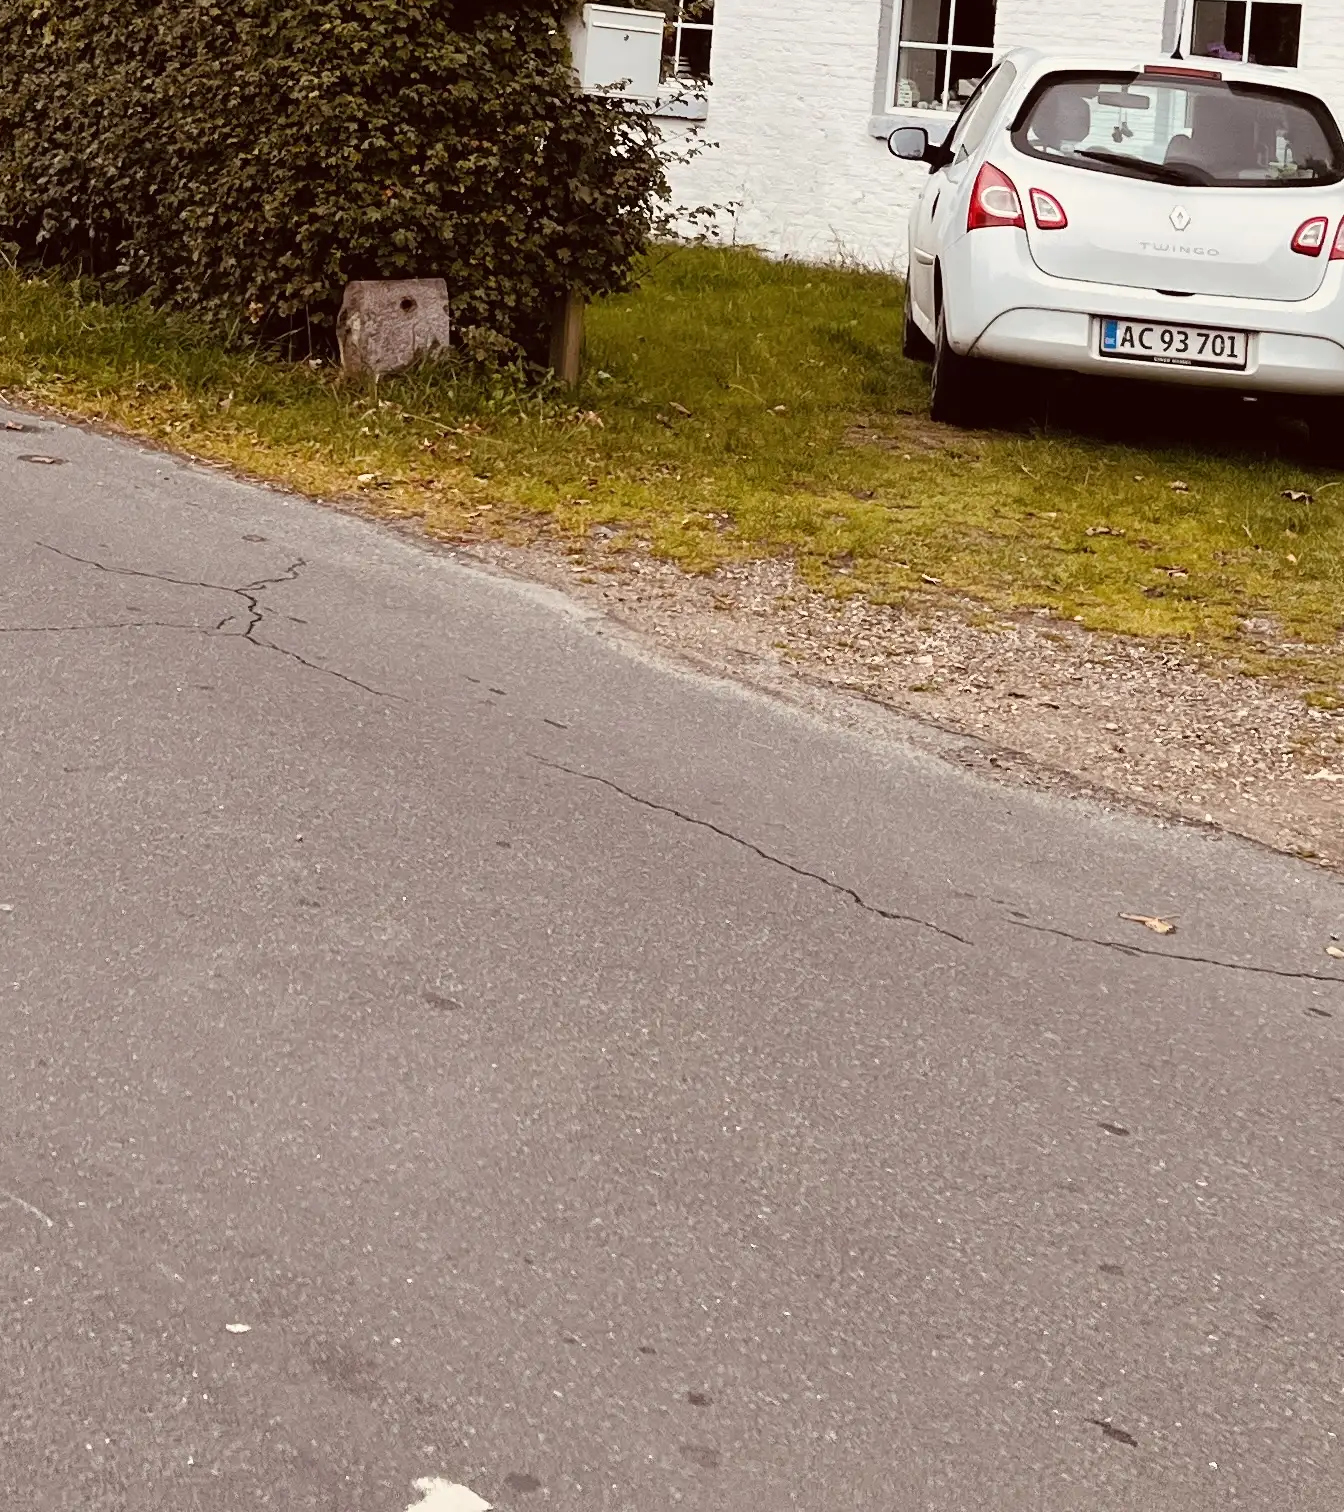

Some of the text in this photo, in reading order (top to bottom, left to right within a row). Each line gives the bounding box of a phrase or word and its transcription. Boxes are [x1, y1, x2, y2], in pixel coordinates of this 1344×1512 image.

[1139, 241, 1220, 256] TWINGO
[1120, 325, 1238, 358] AC 93 701
